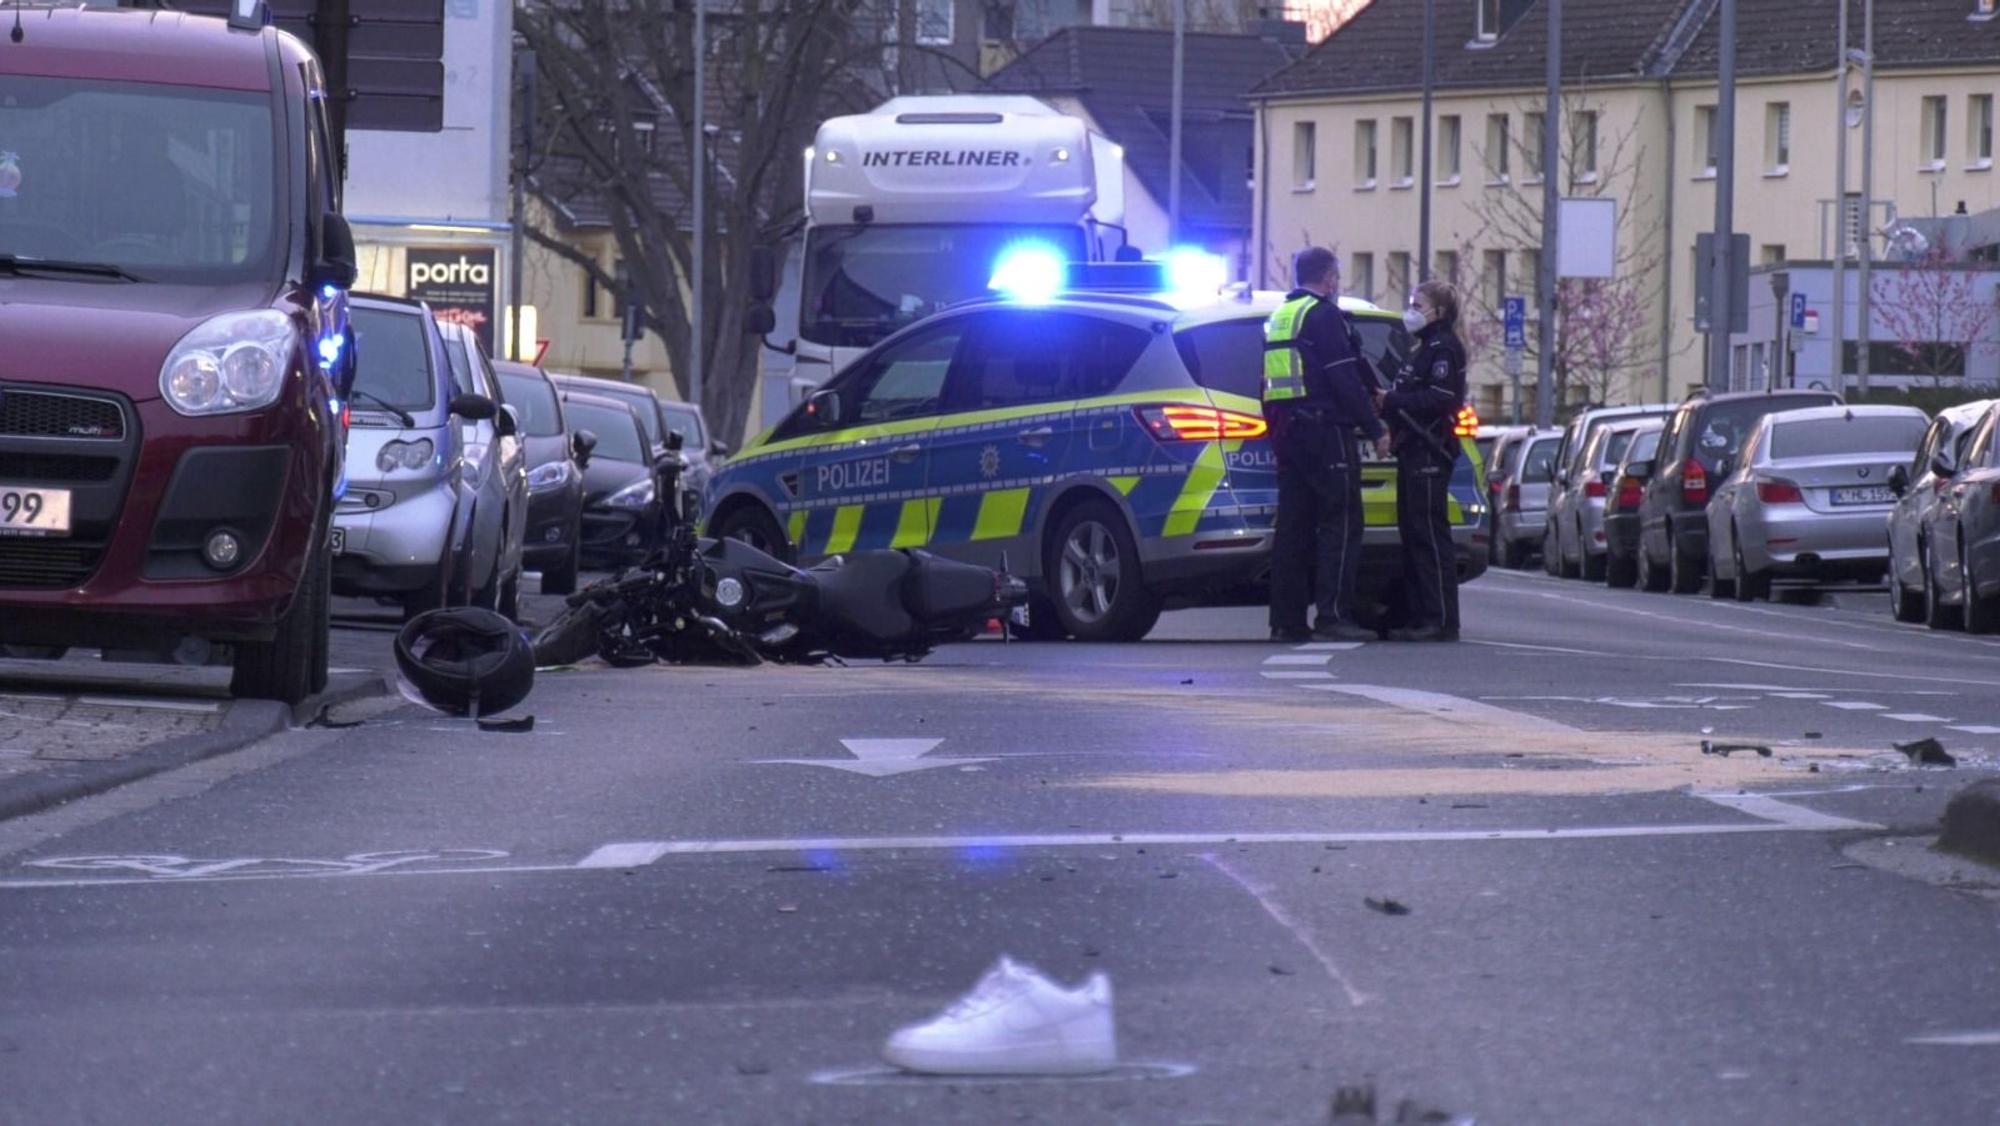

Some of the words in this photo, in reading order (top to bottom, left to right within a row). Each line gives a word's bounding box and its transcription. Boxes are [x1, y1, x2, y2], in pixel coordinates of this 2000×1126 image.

[862, 150, 1020, 167] INTERLINER
[410, 255, 489, 290] porta
[817, 458, 890, 492] POLIZEI
[1, 491, 44, 524] 99
